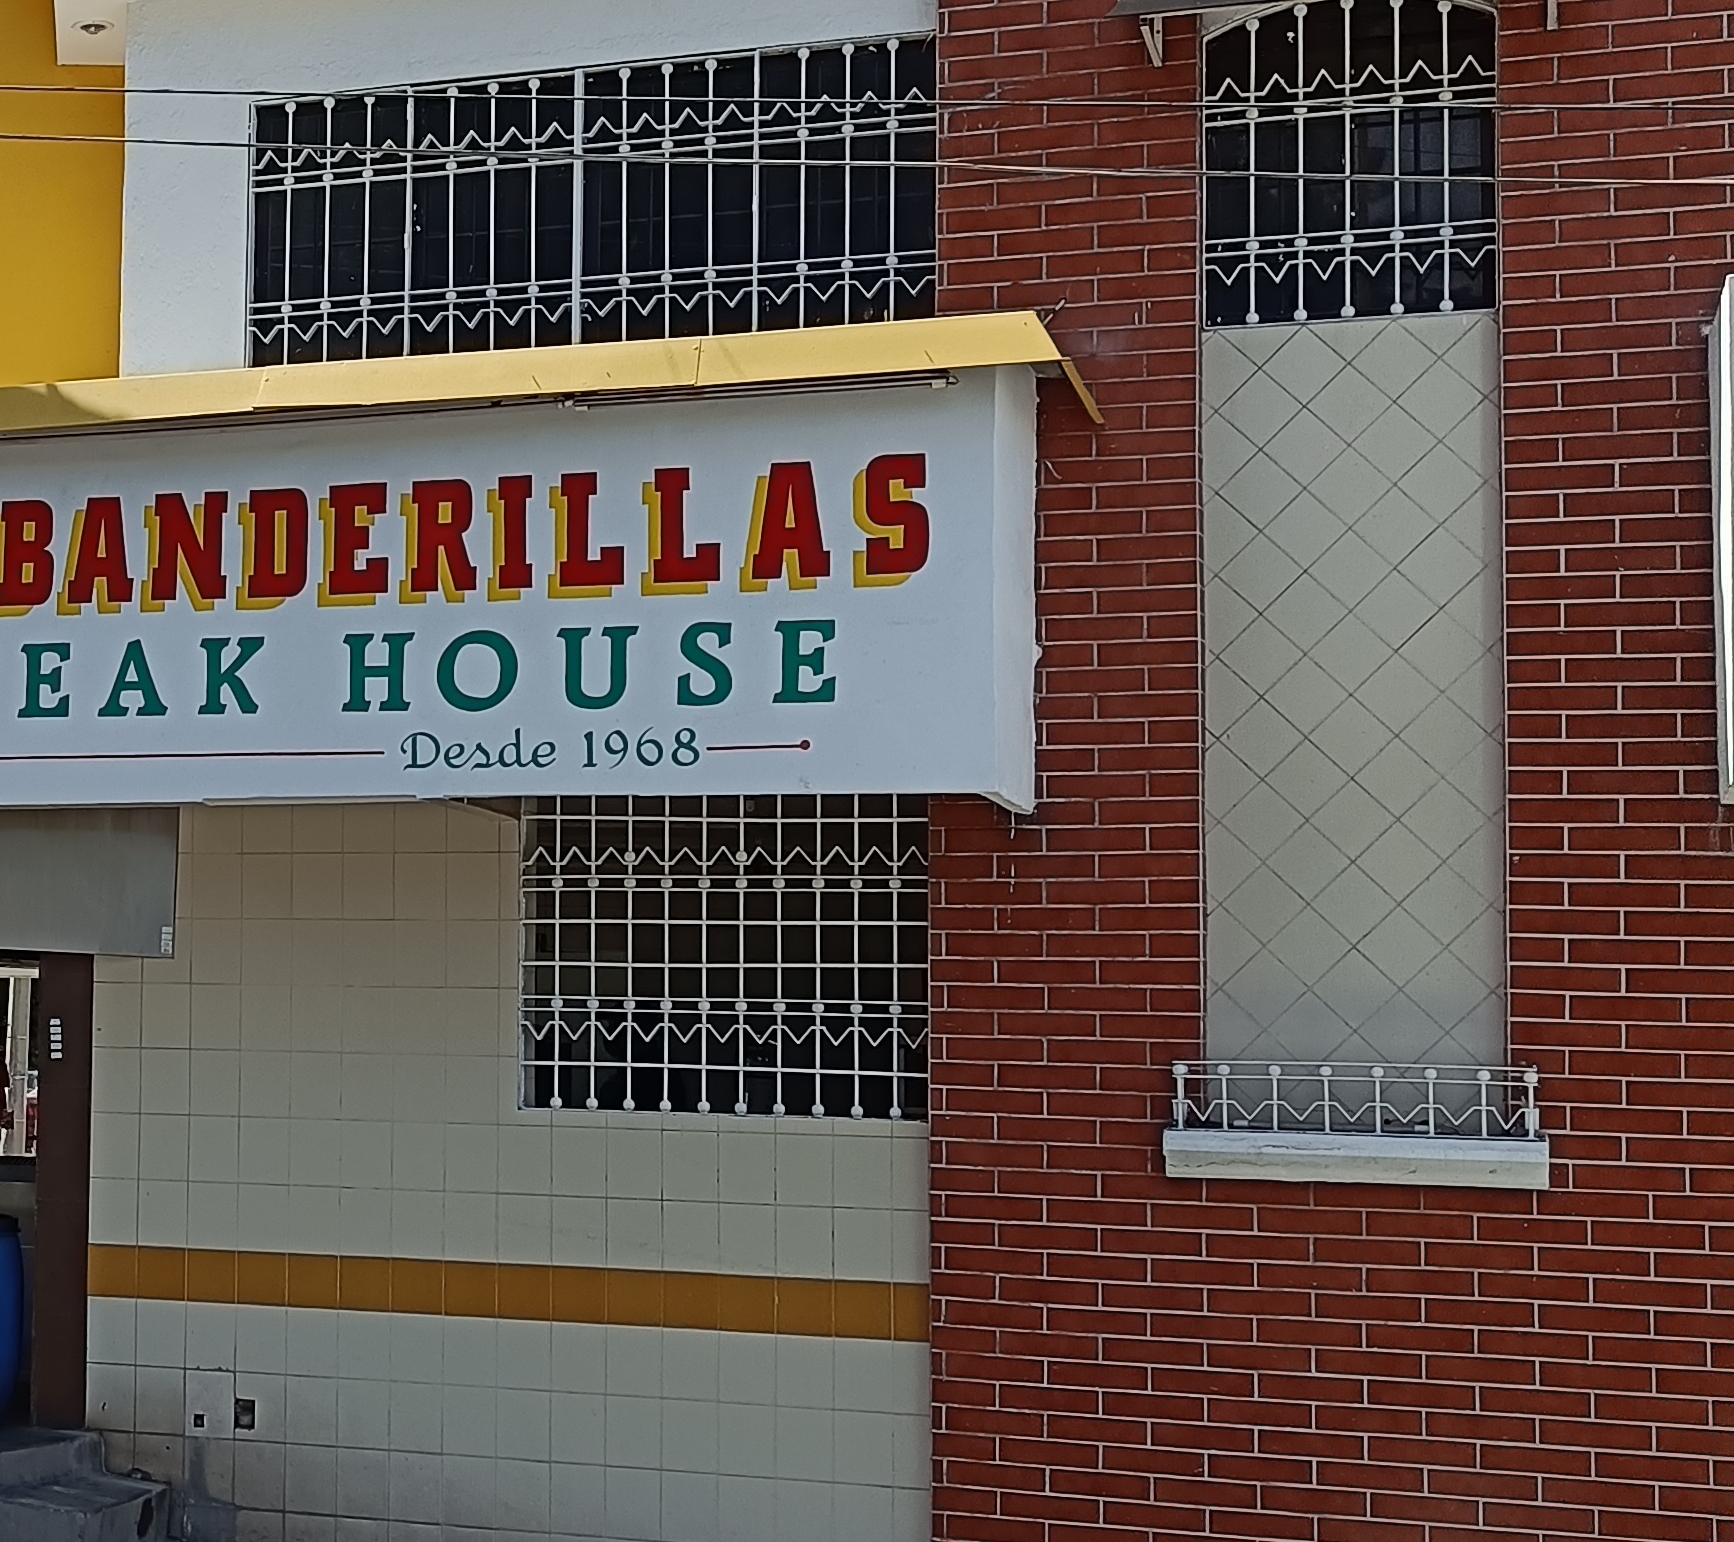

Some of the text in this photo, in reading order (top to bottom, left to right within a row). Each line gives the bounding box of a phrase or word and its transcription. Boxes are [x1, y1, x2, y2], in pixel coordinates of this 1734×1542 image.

[341, 619, 837, 713] HOUSE
[400, 727, 701, 772] Desde 1968
